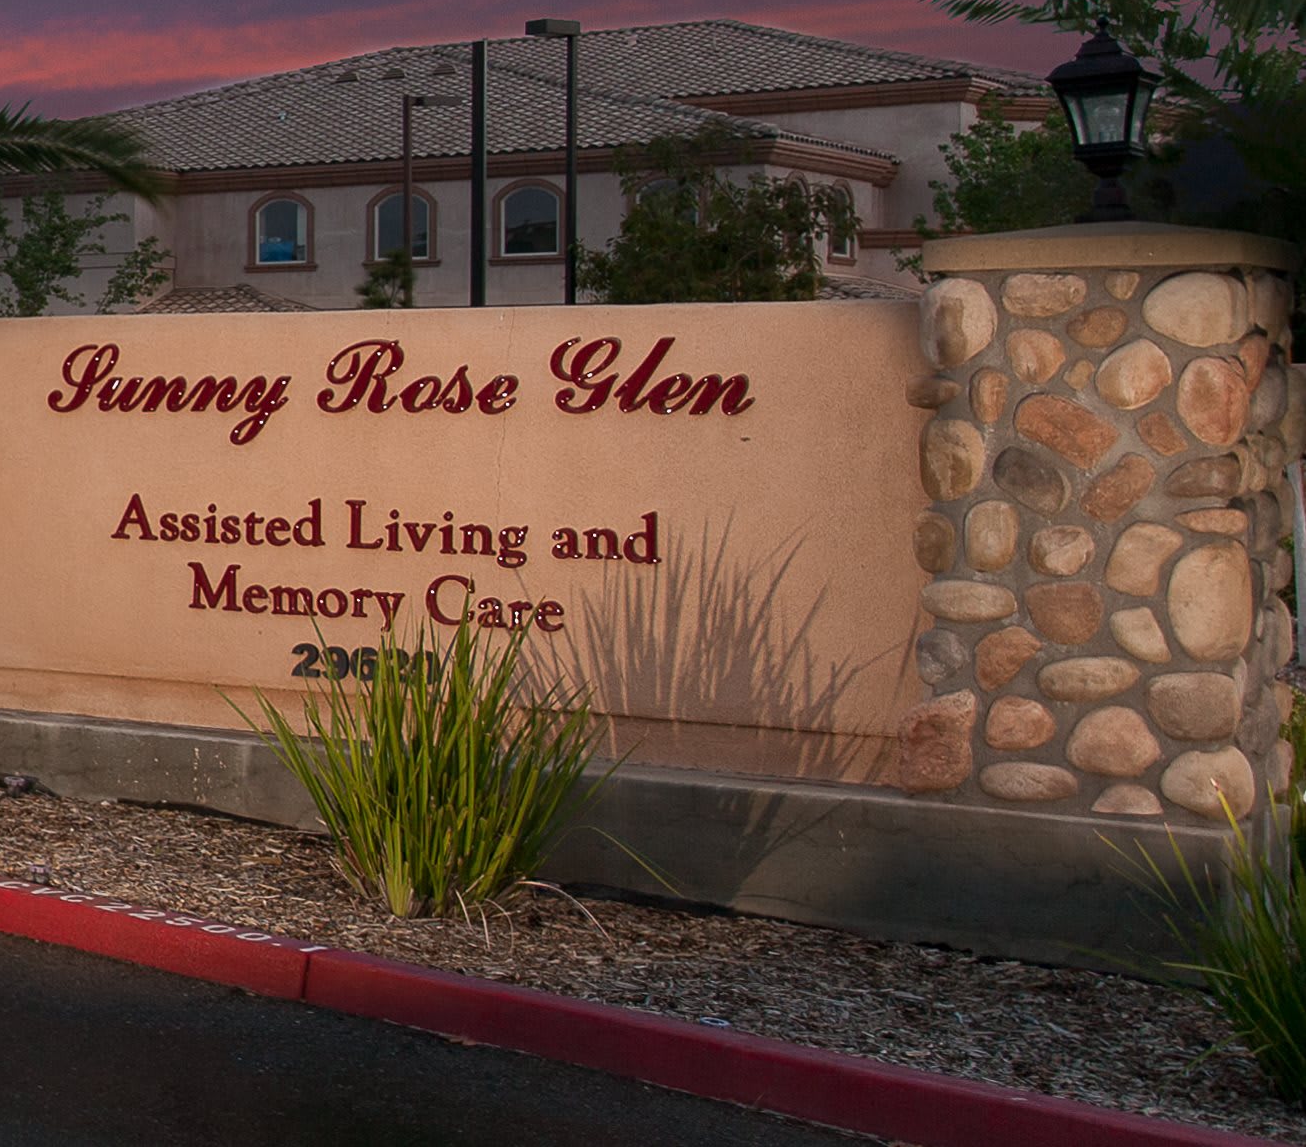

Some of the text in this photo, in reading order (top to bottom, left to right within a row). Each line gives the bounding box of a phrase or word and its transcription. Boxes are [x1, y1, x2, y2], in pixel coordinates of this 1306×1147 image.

[47, 336, 757, 445] Sunny Rose Glen
[110, 492, 663, 570] Assisted Living and
[187, 561, 566, 633] Memory Care
